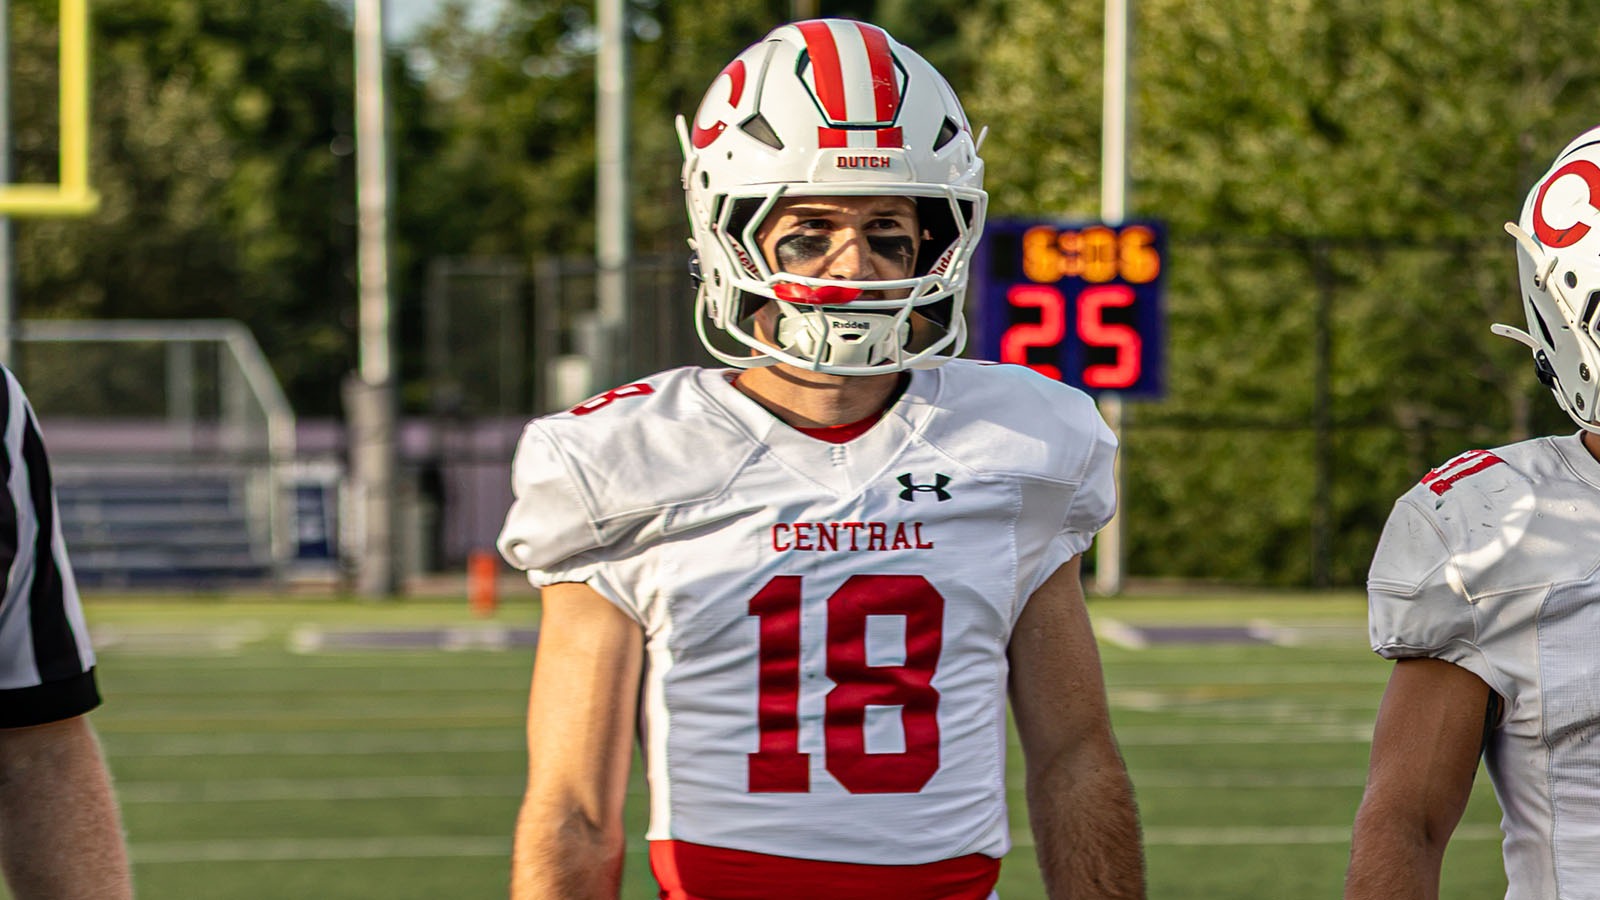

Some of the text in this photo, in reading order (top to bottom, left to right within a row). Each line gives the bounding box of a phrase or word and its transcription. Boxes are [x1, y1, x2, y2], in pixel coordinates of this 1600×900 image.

[836, 156, 891, 168] DUTCH
[1022, 225, 1160, 283] 6:06
[832, 320, 870, 330] Riddell
[1000, 284, 1142, 388] 25
[771, 522, 934, 552] CENTRAL
[748, 575, 945, 793] 18
